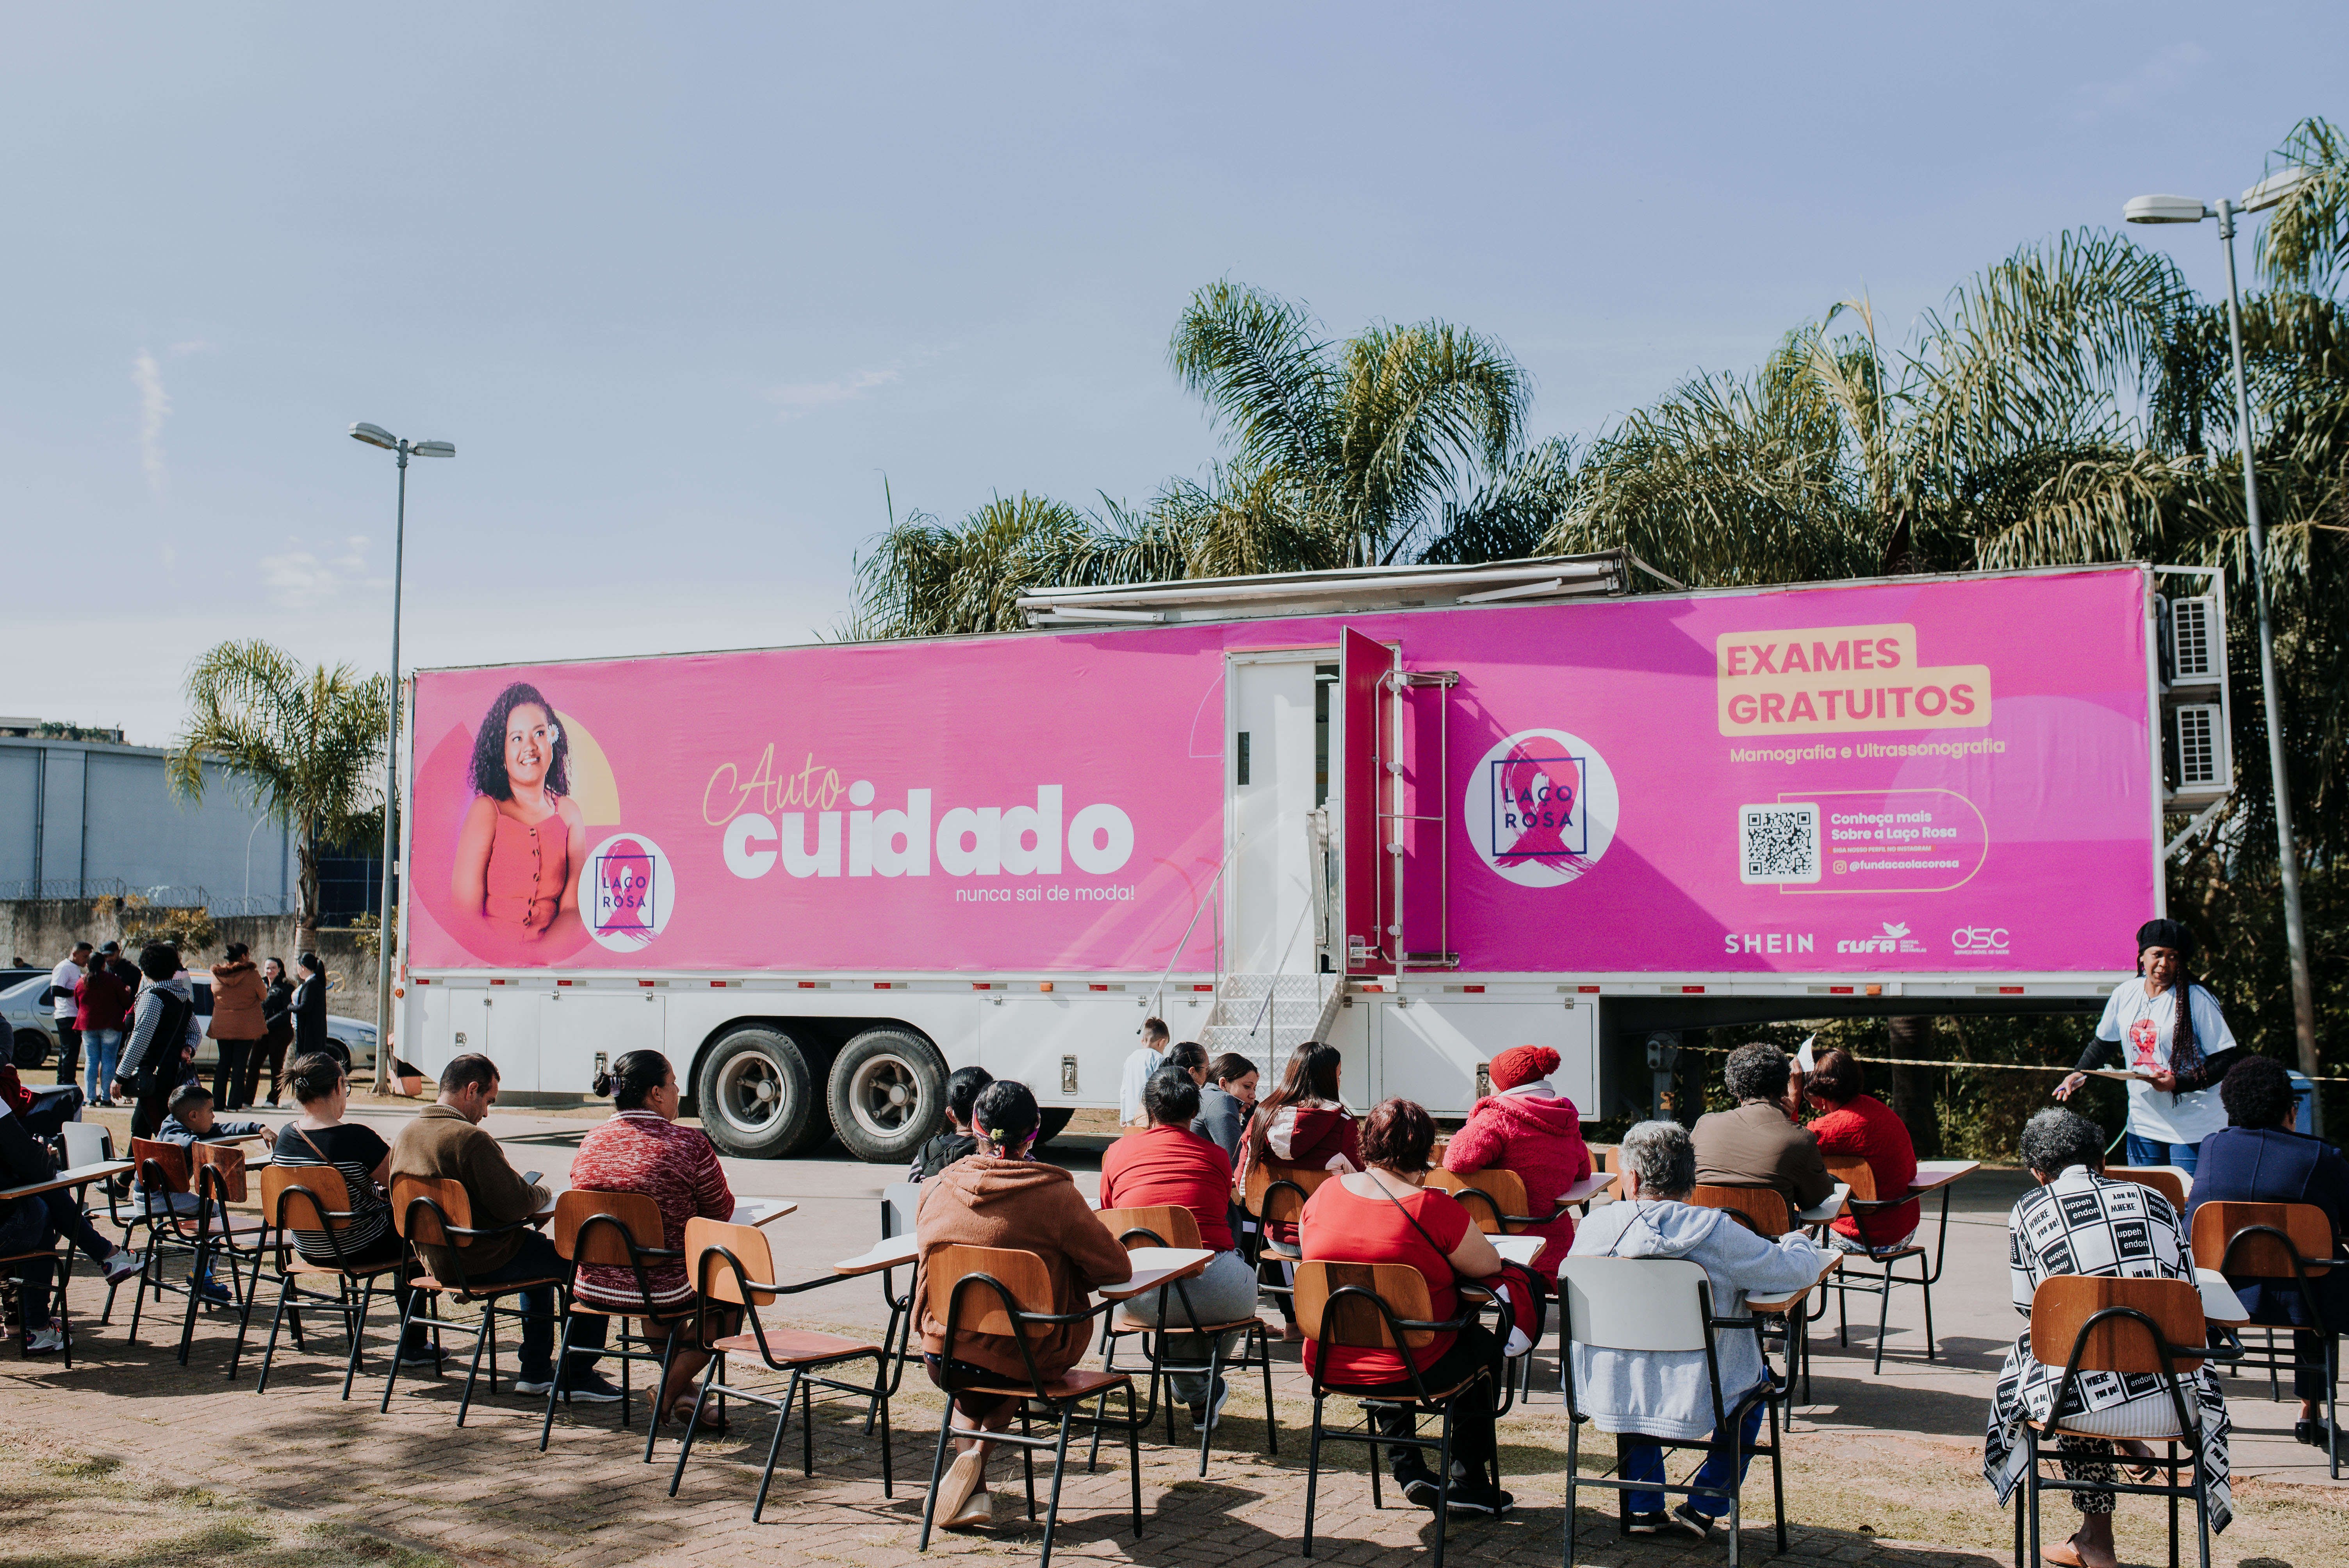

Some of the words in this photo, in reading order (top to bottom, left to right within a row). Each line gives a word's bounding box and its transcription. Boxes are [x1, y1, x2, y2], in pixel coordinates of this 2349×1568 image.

[1727, 638, 1901, 676] EXAMES
[1728, 684, 1975, 725] GRATUITOS
[1730, 744, 1836, 765] Mamografia
[1841, 748, 1852, 759] e
[1857, 738, 2005, 759] Ultrassonografia
[703, 743, 847, 826] Auto
[1505, 786, 1572, 807] LAÇO
[1505, 811, 1574, 828] ROSA
[1831, 813, 1894, 827] Conheça
[1896, 810, 1932, 823] mais
[723, 780, 1134, 879] cuidado
[1831, 828, 1871, 840] Sobre
[1874, 829, 1884, 839] a
[1887, 828, 1919, 842] Laço
[1922, 827, 1957, 838] Rosa
[1849, 859, 1959, 872] @fundacaolacorosa
[603, 876, 646, 892] LAÇO
[956, 887, 1011, 902] nunca
[1016, 885, 1041, 901] sai
[1047, 885, 1069, 901] de
[1075, 884, 1135, 901] moda!
[603, 896, 647, 908] ROSA
[1725, 934, 1814, 953] SHEIN
[1837, 940, 1896, 953] CUFA
[2065, 1199, 2092, 1210] uppeh
[2073, 1207, 2099, 1219] endon
[2028, 1208, 2050, 1230] WHERE
[2037, 1226, 2048, 1239] you
[2048, 1217, 2060, 1230] go!
[2117, 1228, 2142, 1238] uppeh
[2124, 1240, 2148, 1249] endon
[2084, 1372, 2110, 1387] WHERE
[2131, 1374, 2154, 1387] endon
[2094, 1388, 2108, 1400] you
[2107, 1383, 2119, 1396] go!
[2011, 1405, 2026, 1420] uppeh
